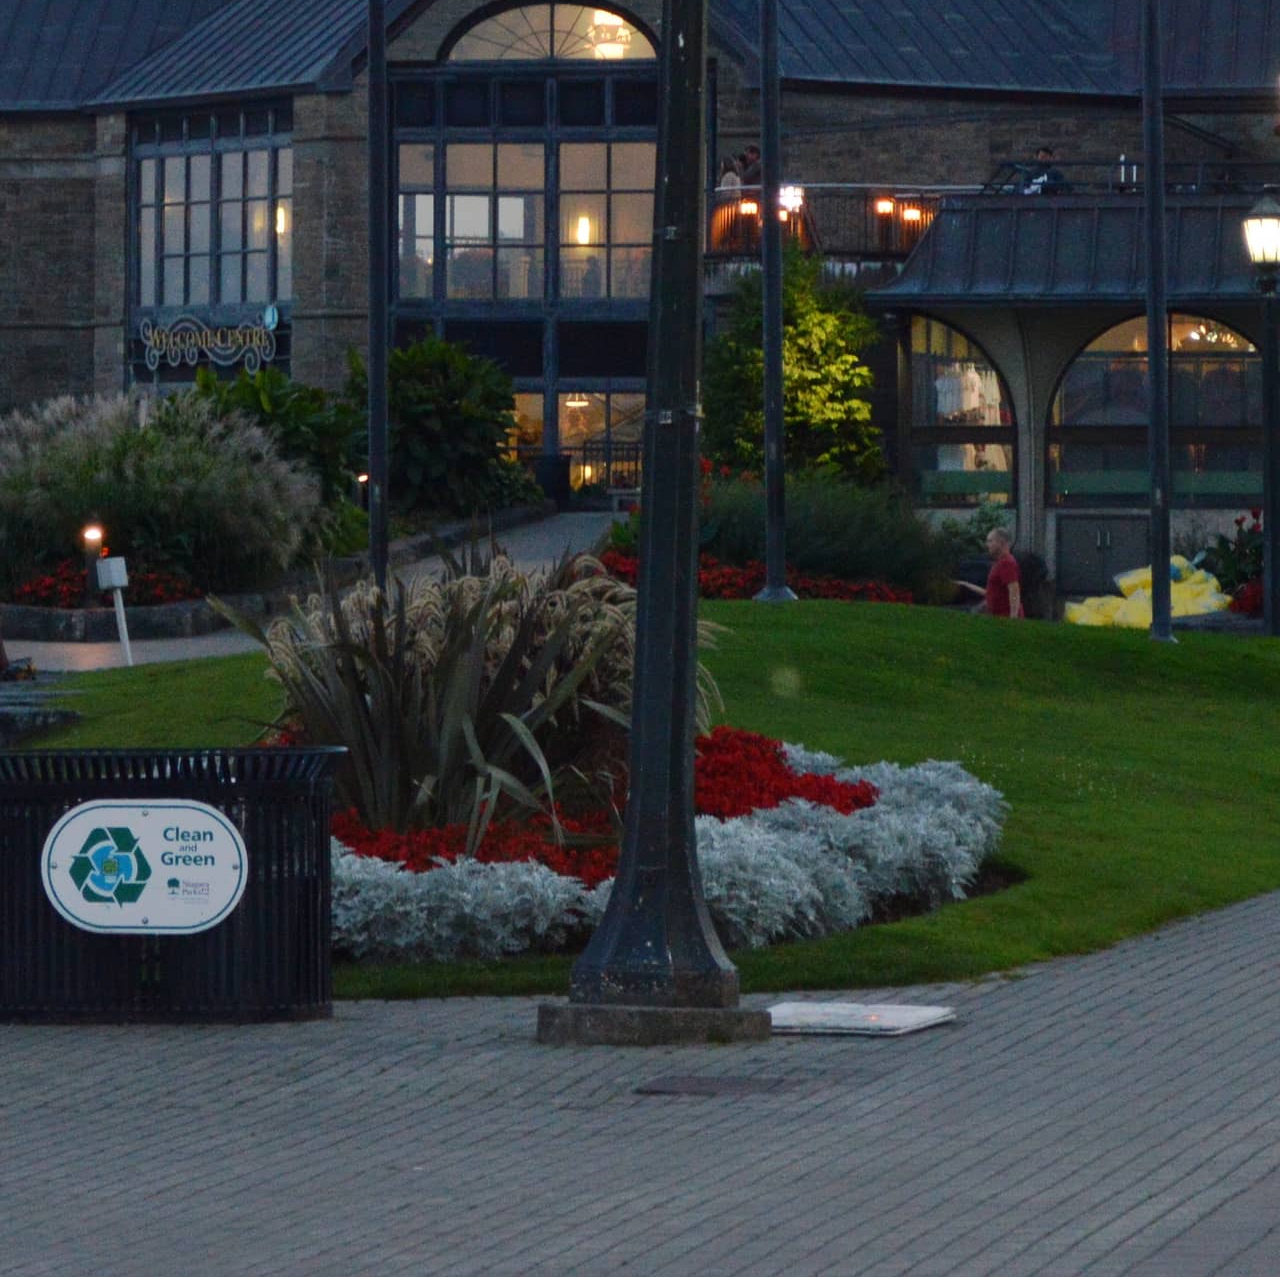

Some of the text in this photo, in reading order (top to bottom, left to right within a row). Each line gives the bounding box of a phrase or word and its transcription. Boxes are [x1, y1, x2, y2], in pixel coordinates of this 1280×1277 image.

[163, 827, 213, 842] Clean
[179, 844, 197, 852] and
[161, 851, 215, 866] Green
